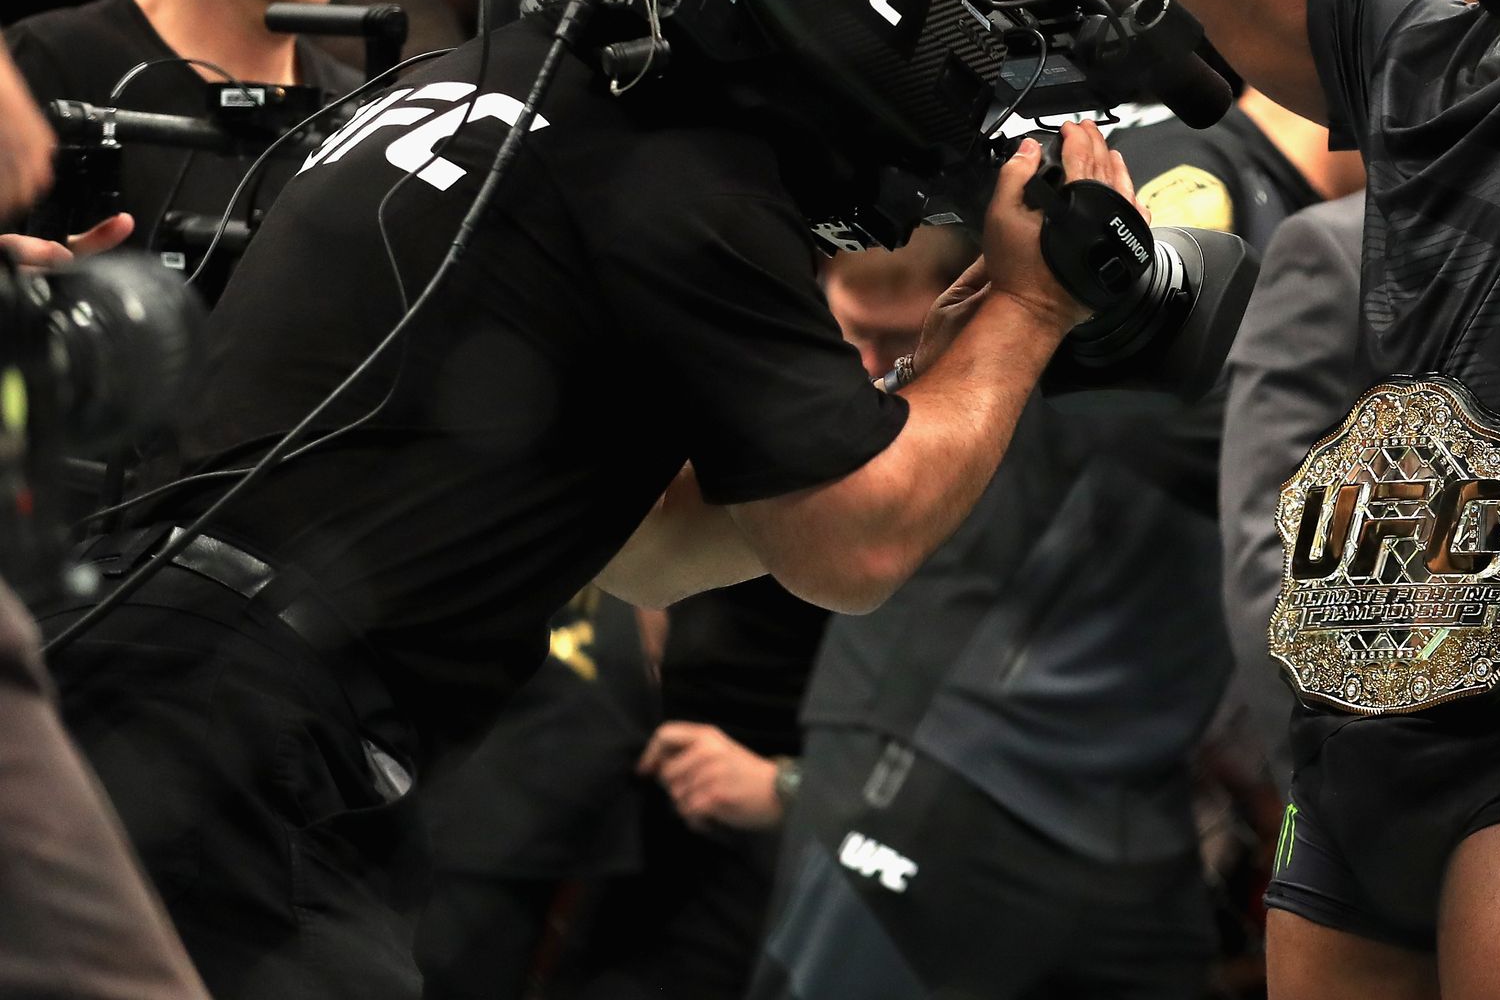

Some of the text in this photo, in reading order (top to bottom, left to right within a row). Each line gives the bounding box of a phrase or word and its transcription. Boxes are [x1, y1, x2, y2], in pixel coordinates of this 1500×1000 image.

[295, 81, 550, 192] UFC
[1109, 216, 1149, 264] FUJINON
[1301, 602, 1485, 629] CHAMPIONSHIP
